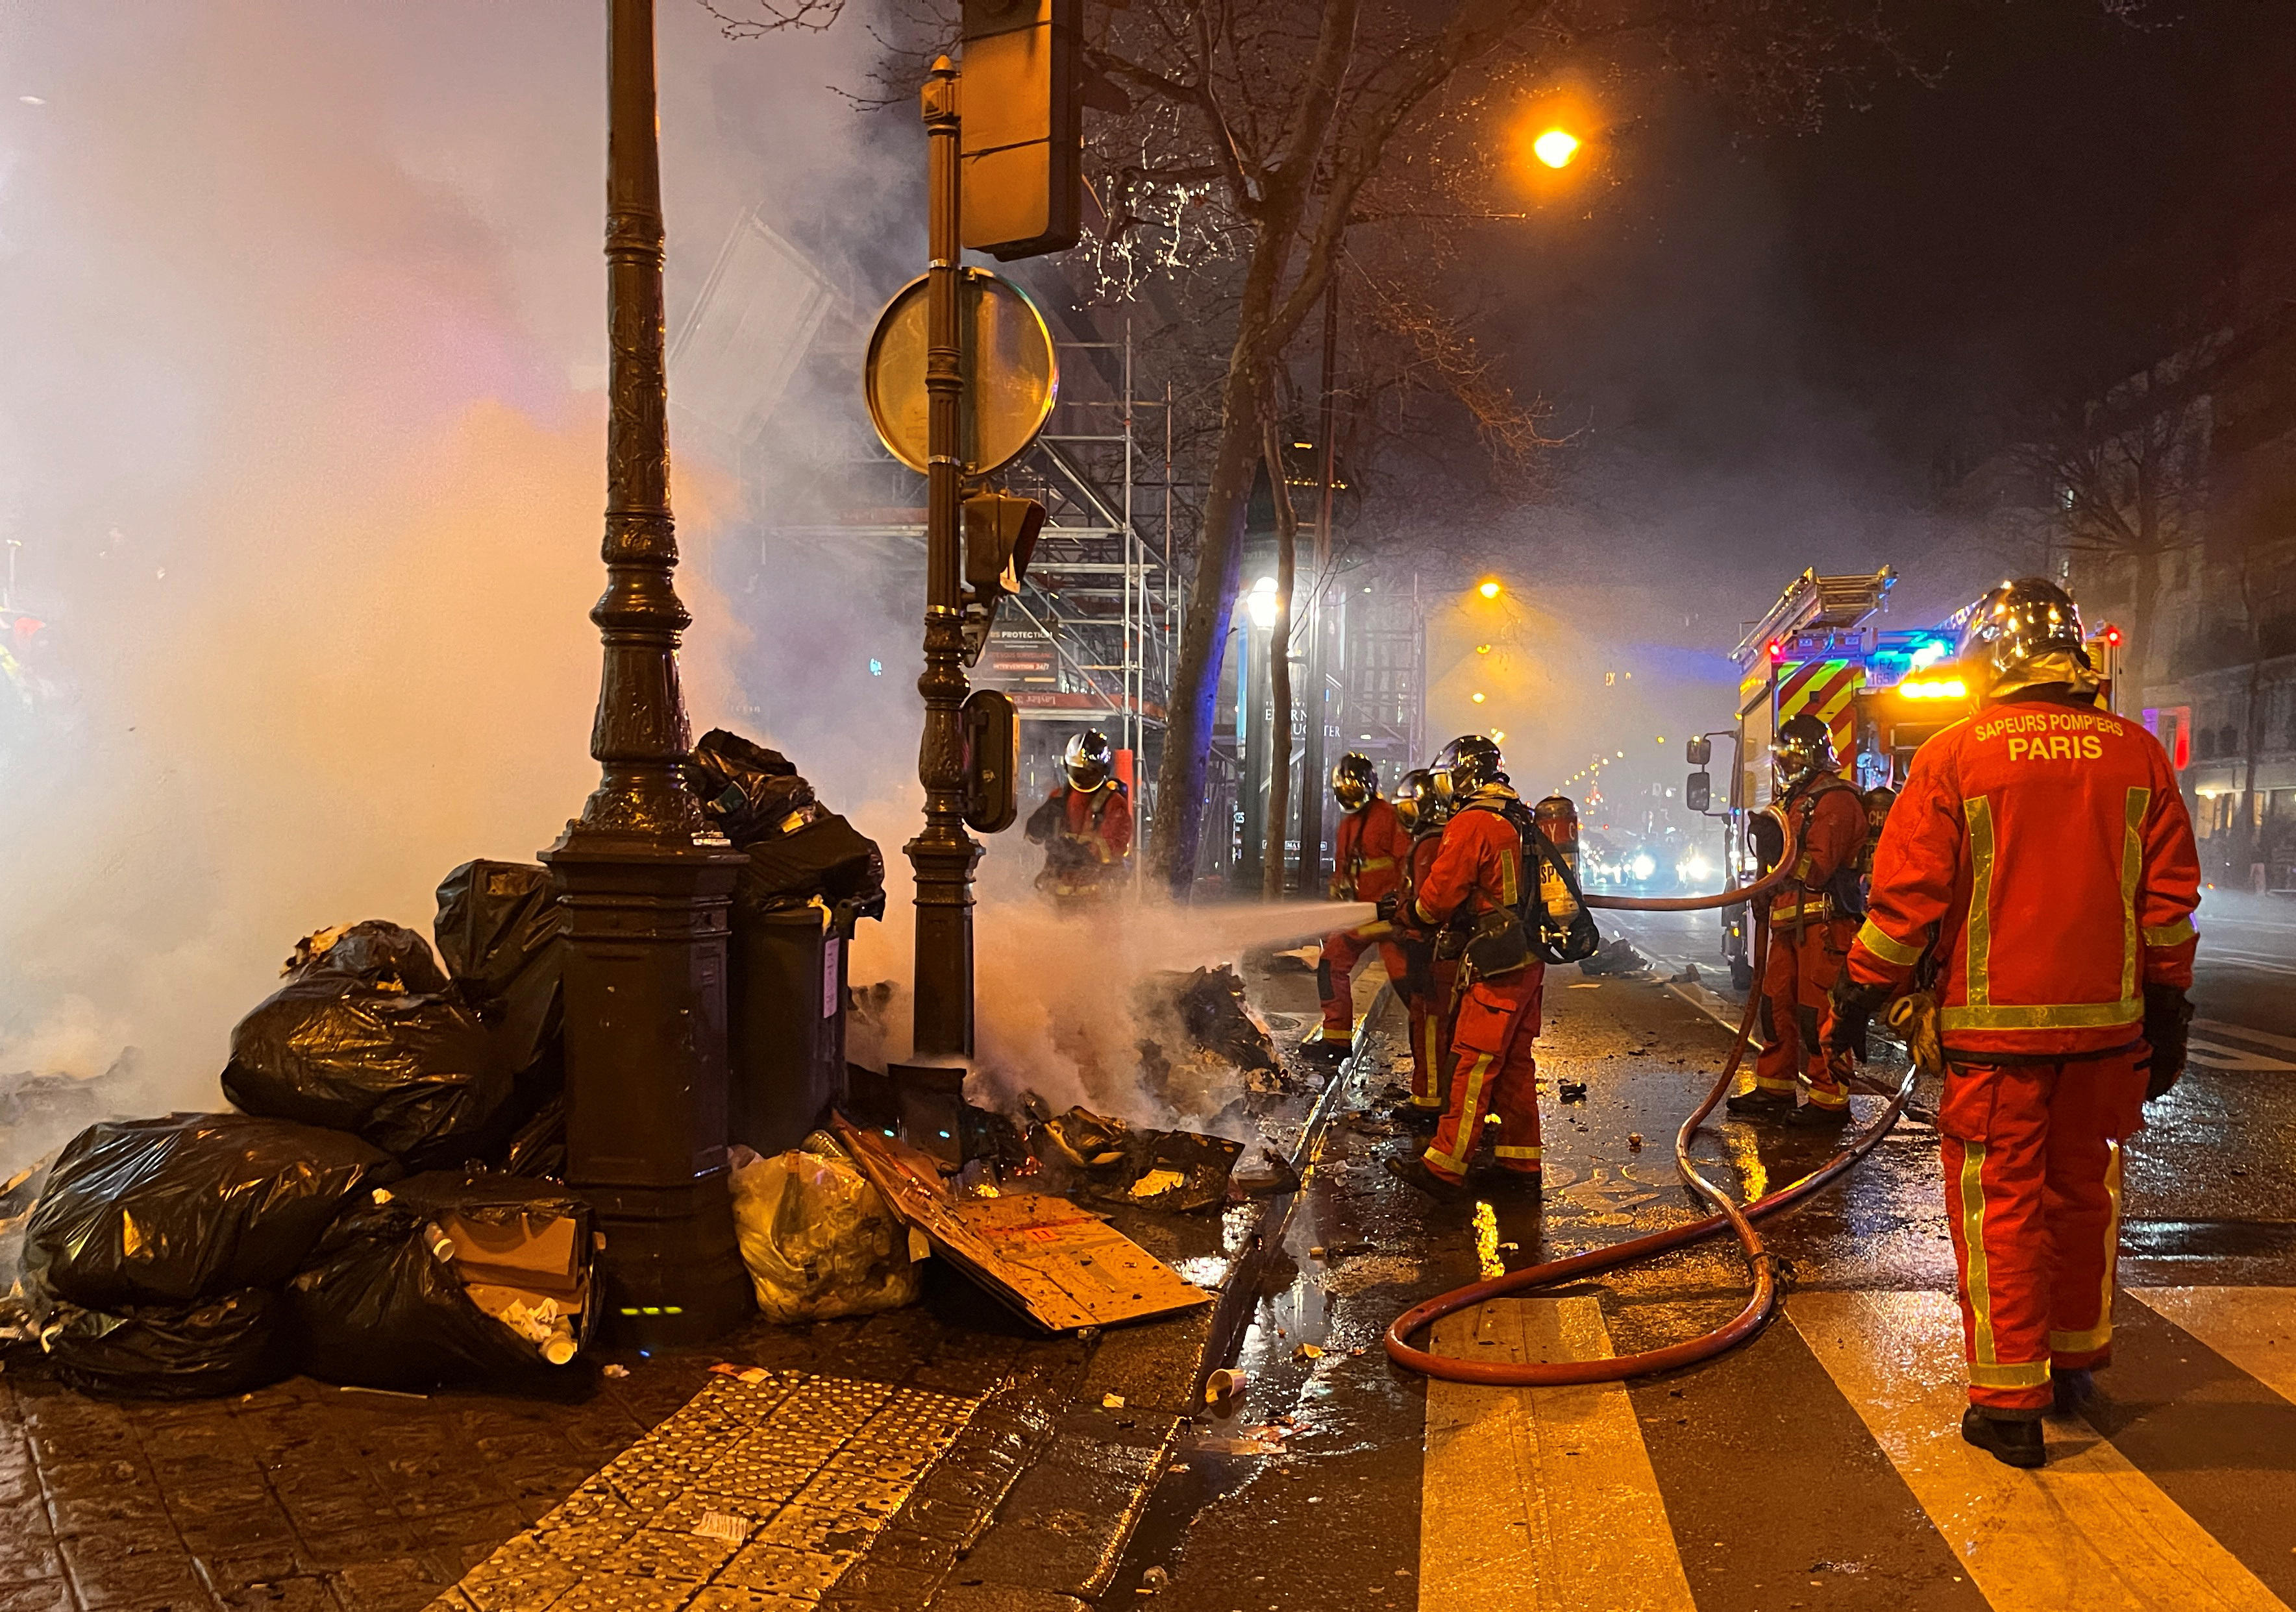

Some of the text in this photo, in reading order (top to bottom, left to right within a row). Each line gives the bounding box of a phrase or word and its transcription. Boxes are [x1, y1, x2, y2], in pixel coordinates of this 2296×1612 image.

[1974, 714, 2124, 742] SAPEURS POMPIERS
[2008, 736, 2103, 761] PARIS
